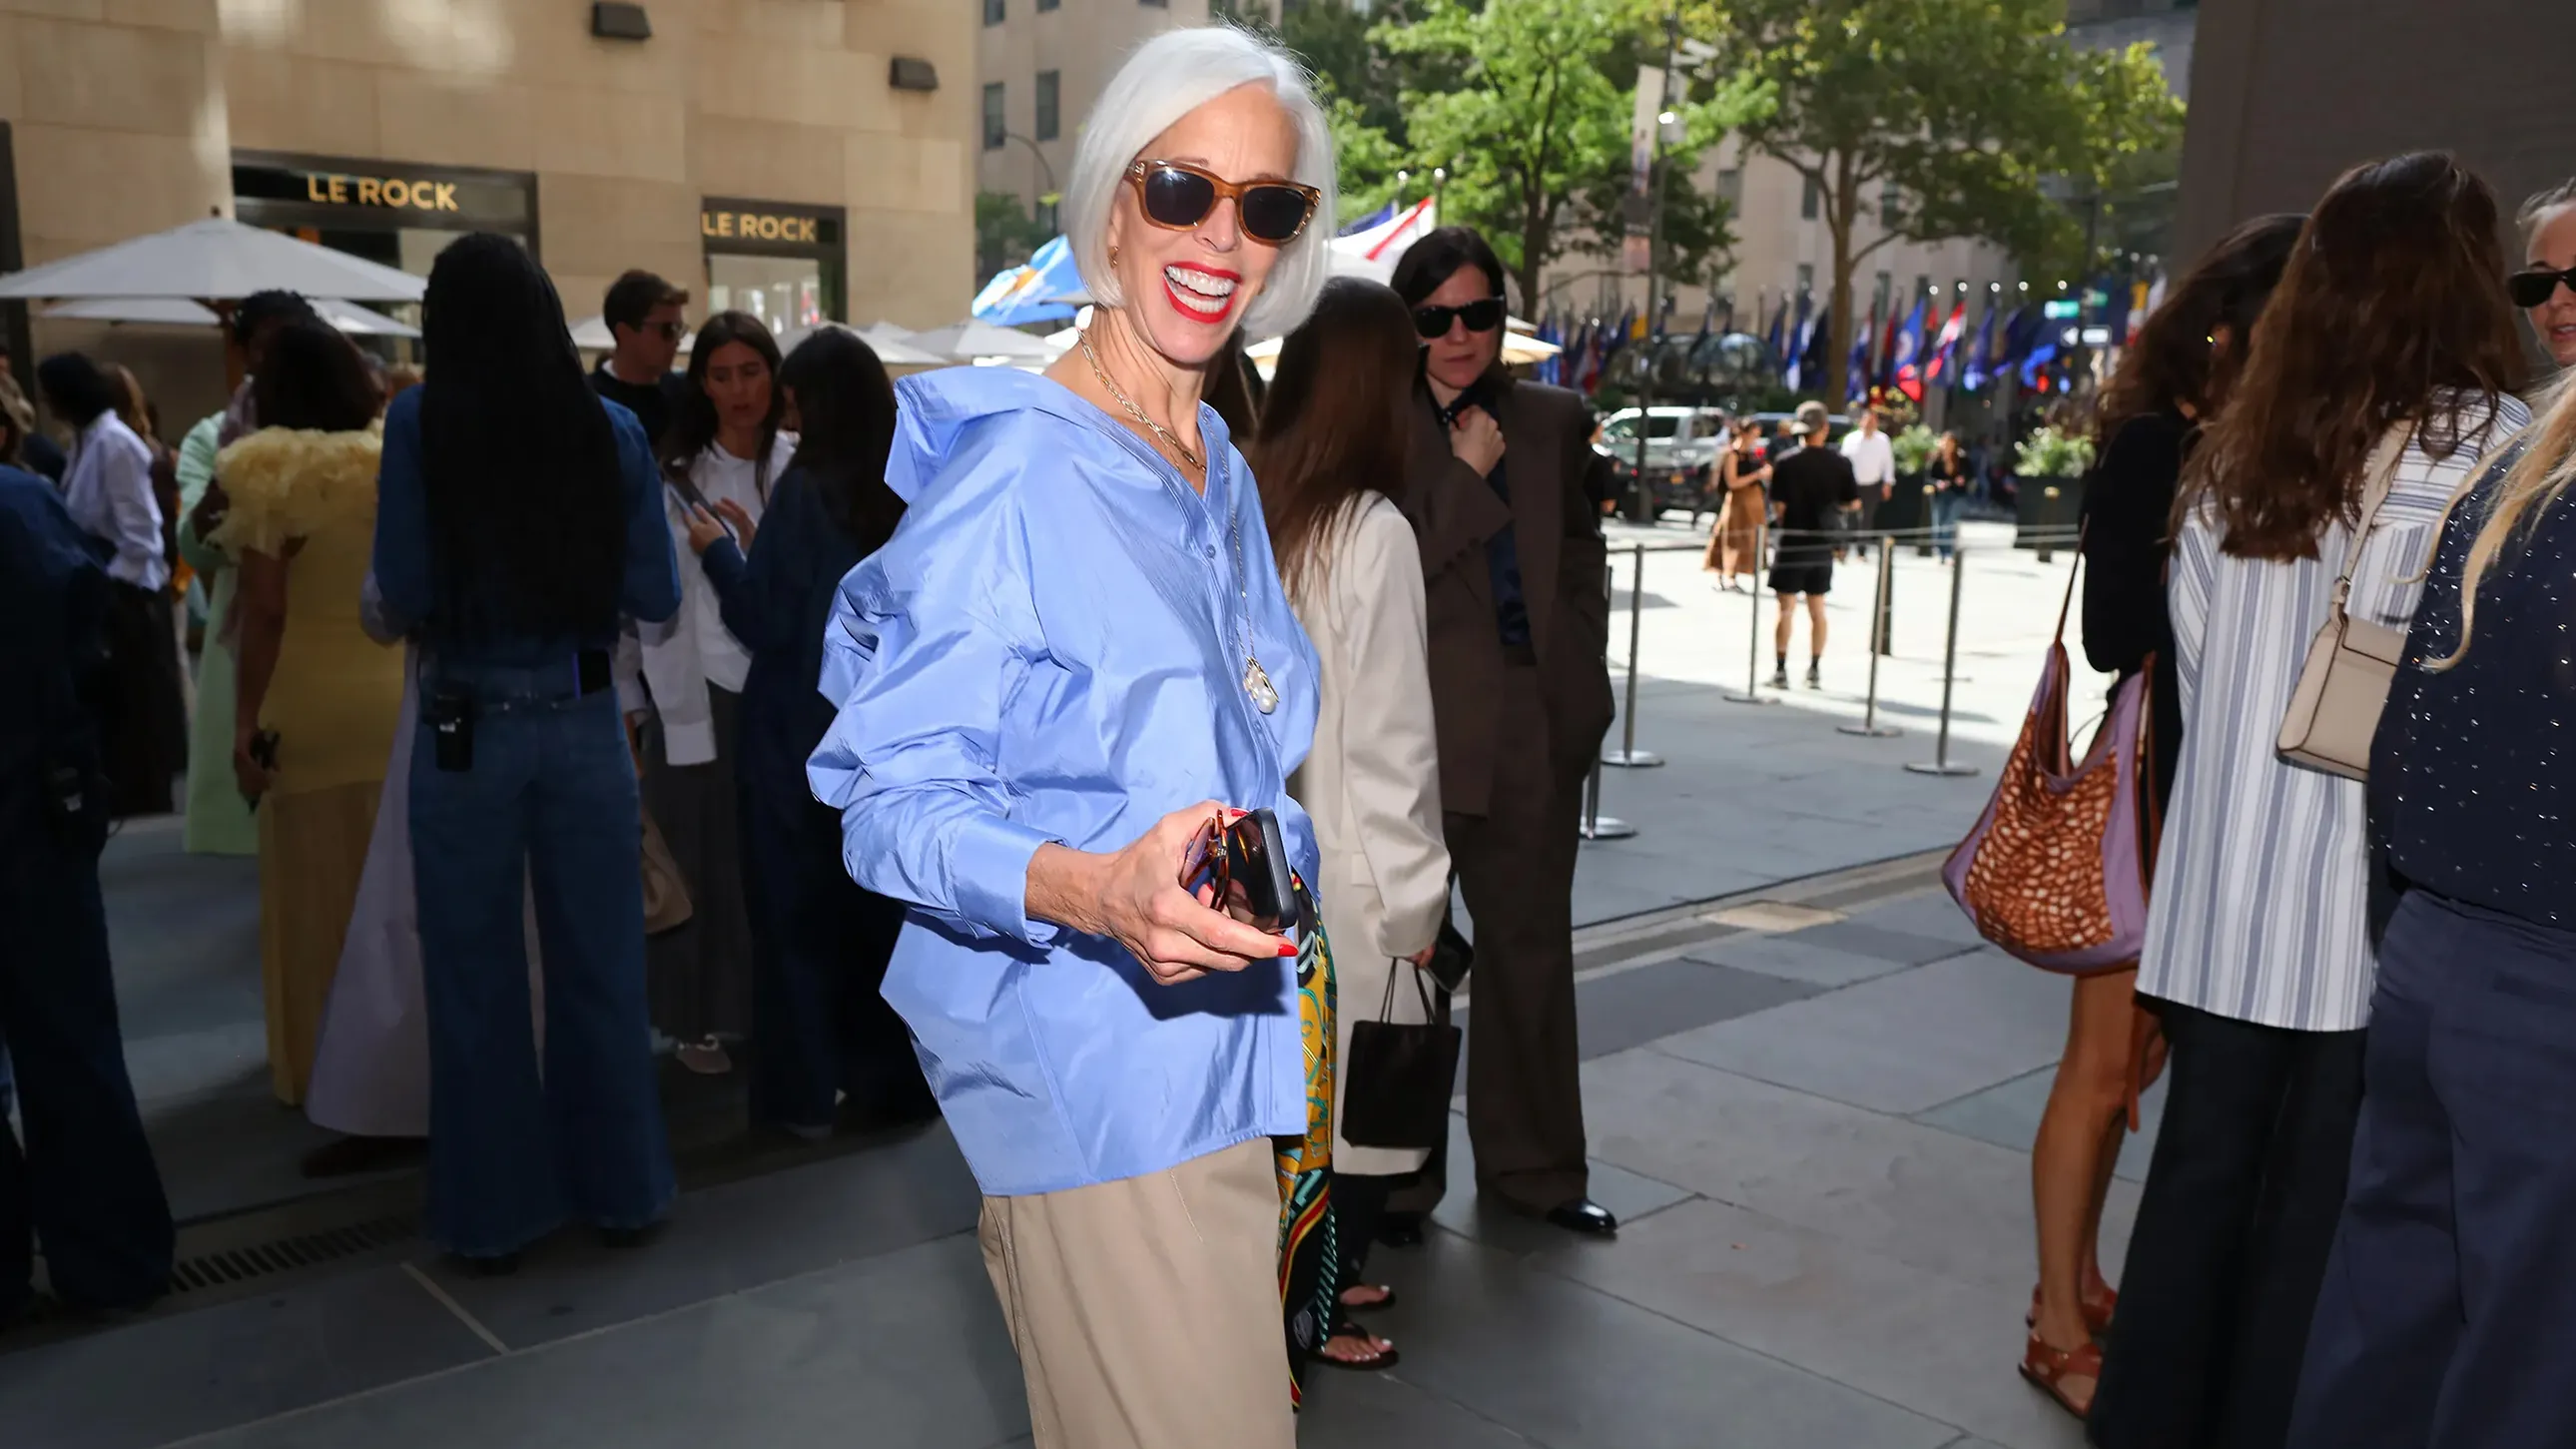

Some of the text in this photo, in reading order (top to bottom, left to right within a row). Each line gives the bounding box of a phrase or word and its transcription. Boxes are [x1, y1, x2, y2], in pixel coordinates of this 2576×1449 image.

[308, 173, 459, 212] LE ROCK
[701, 211, 817, 244] LE ROCK
